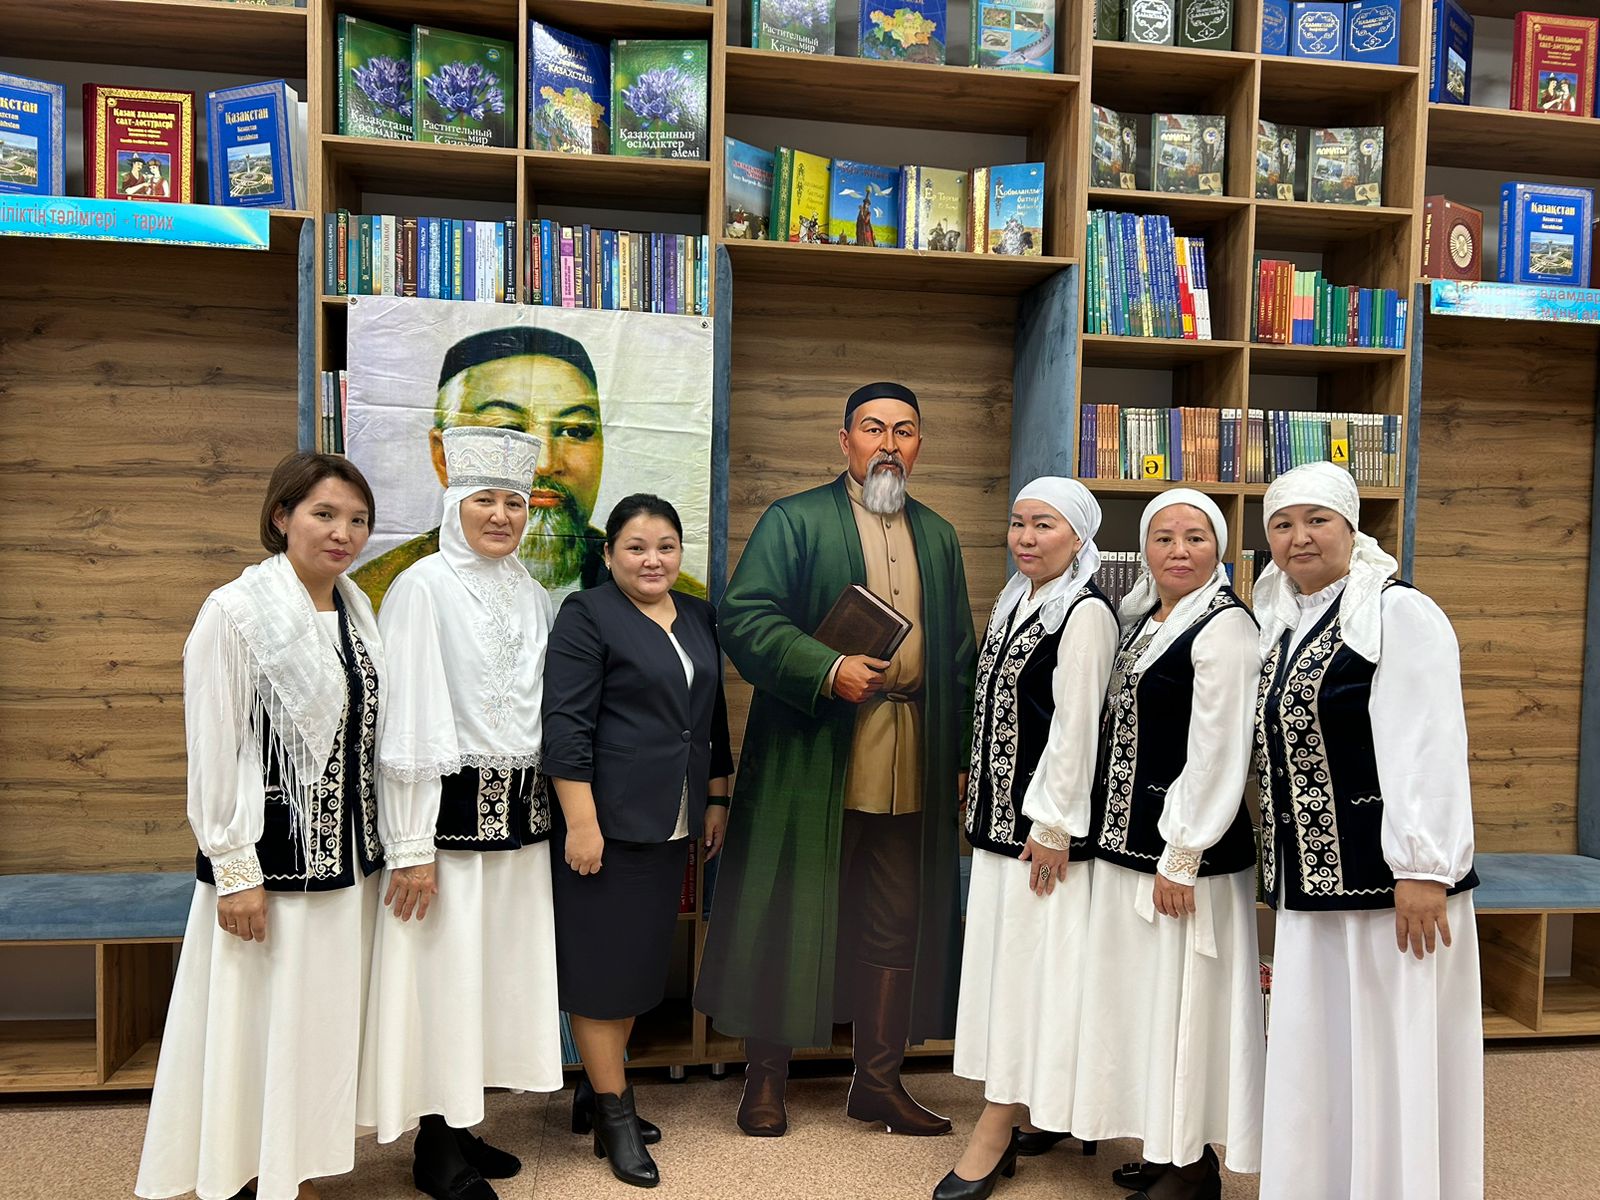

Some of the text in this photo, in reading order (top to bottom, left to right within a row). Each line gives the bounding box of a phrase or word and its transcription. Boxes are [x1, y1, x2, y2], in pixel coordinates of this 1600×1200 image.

[762, 21, 819, 47] Растительный
[799, 42, 815, 54] мир
[225, 108, 269, 125] Қазақстан
[351, 109, 413, 133] Қазақстанн
[422, 119, 492, 138] Растительный
[619, 128, 696, 142] Қазақстанның
[467, 135, 489, 145] мир
[626, 140, 685, 152] өсімдіктер
[671, 147, 700, 158] әлемі
[1530, 201, 1576, 217] Қазақстан
[49, 204, 118, 232] тәлімгері
[133, 212, 174, 234] тарих
[1332, 445, 1345, 458] А
[1145, 460, 1159, 475] Ә
